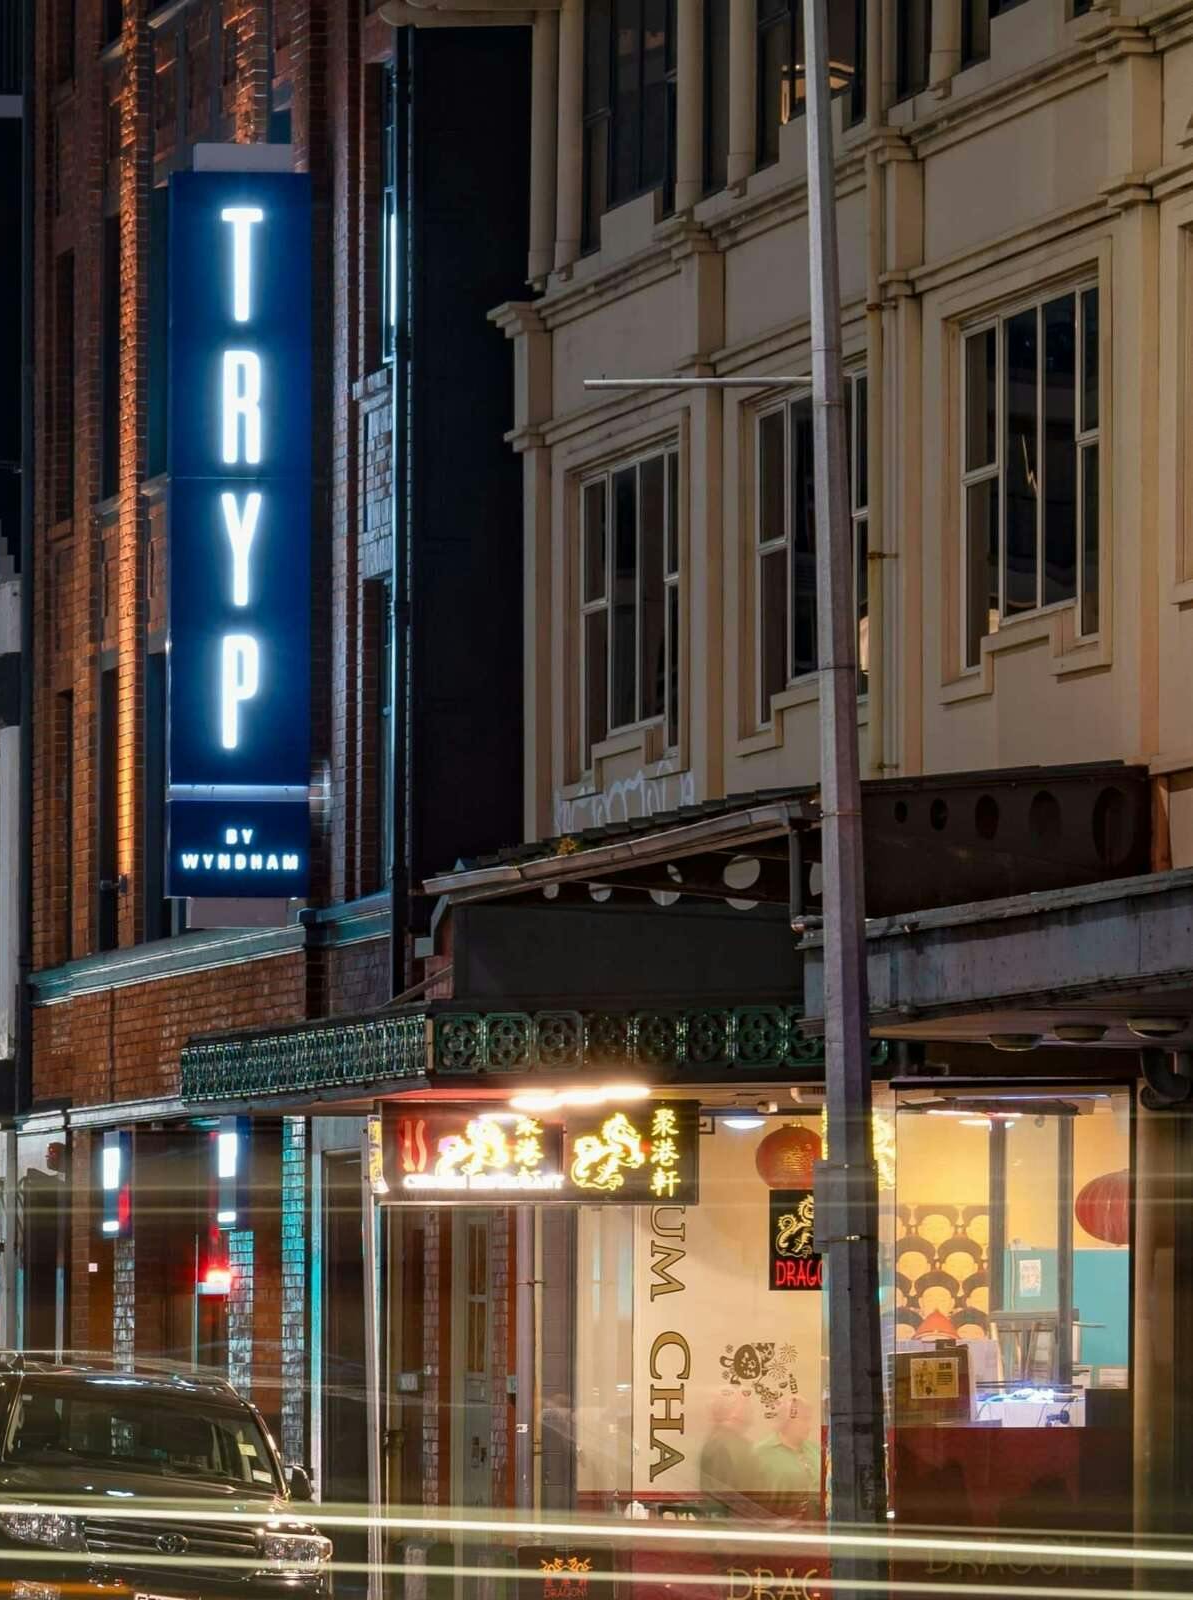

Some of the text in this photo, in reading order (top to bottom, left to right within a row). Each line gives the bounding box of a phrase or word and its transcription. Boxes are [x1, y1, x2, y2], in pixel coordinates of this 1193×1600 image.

[220, 207, 264, 749] TRYP
[225, 828, 254, 845] BY
[182, 853, 299, 870] WYNDHAM
[775, 1260, 824, 1287] DRAGO
[649, 1204, 692, 1483] UM CHA
[726, 1567, 821, 1600] DRAG
